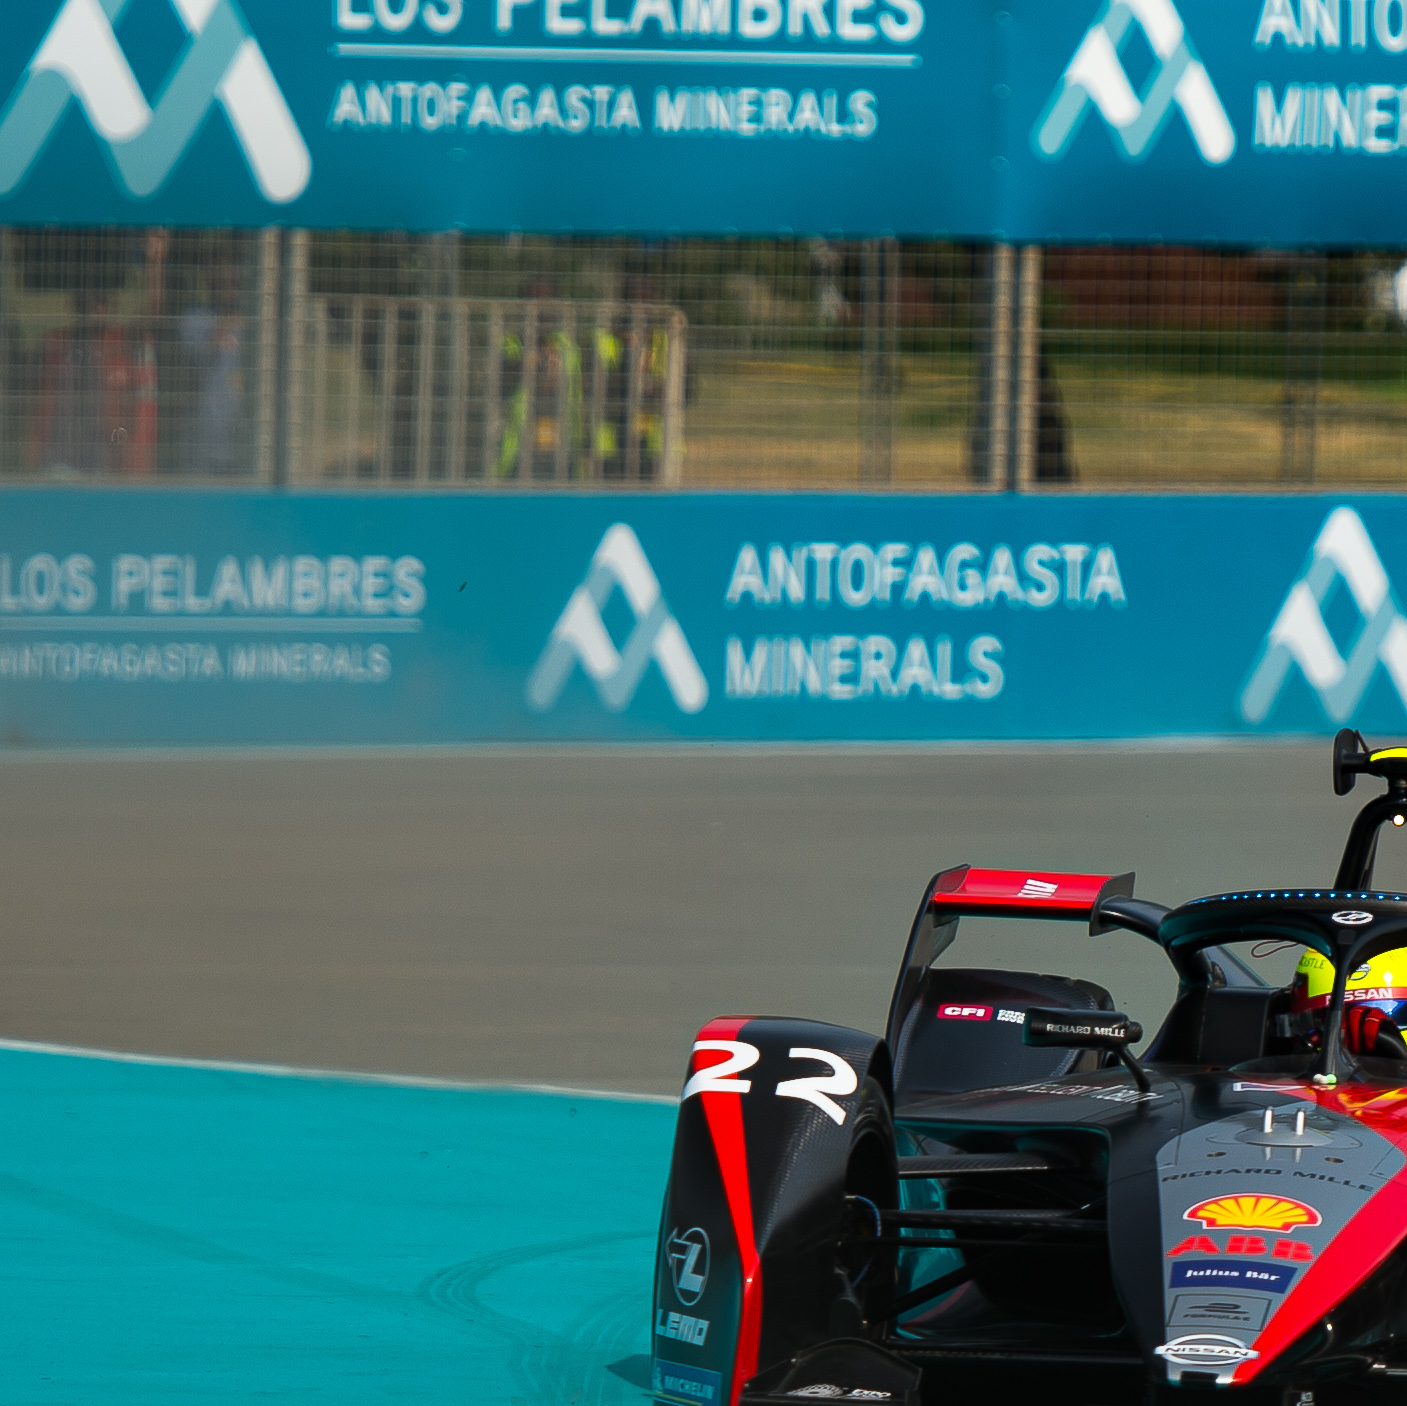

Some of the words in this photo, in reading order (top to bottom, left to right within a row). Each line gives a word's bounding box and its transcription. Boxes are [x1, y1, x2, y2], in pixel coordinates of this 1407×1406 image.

[330, 81, 640, 132] ANTOFAGASTA
[653, 87, 879, 138] MINERALS
[112, 554, 426, 615] PELAMBRES
[725, 541, 1128, 609] ANTOFAGASTA
[726, 634, 1005, 700] MINERALS
[944, 1007, 985, 1017] CFI
[1046, 1023, 1091, 1035] RICHARD
[682, 1040, 858, 1126] 22
[1161, 1168, 1283, 1182] RICHARD
[1293, 1171, 1375, 1192] MILLE
[1165, 1233, 1315, 1262] ABB
[1185, 1269, 1240, 1278] Julius
[655, 1308, 710, 1347] LEMO
[1165, 1347, 1249, 1357] NISSAN
